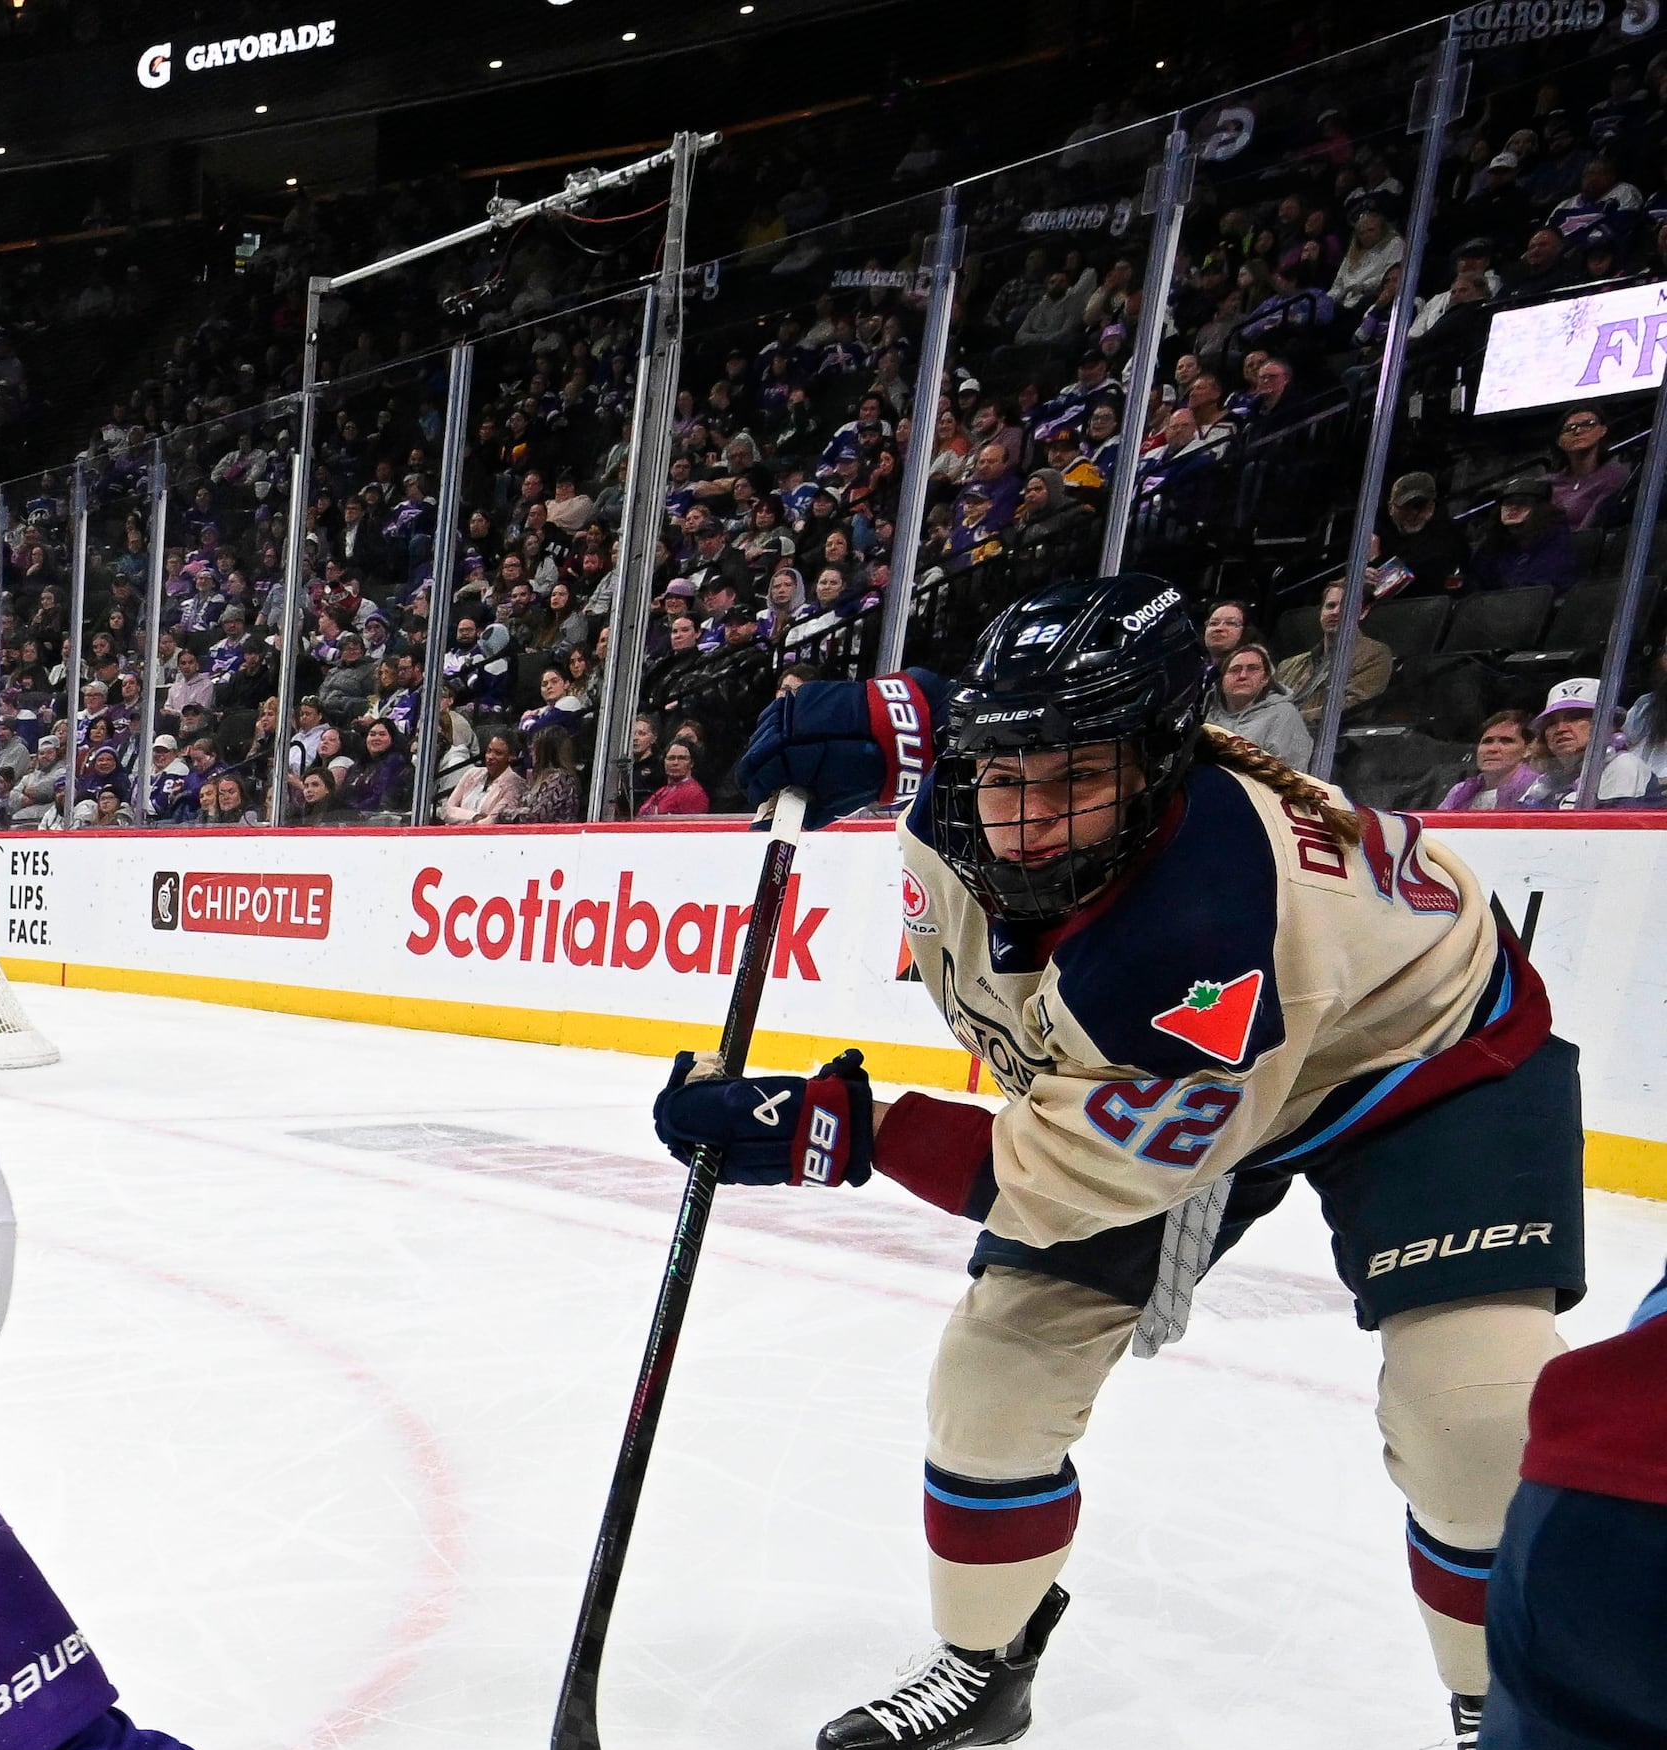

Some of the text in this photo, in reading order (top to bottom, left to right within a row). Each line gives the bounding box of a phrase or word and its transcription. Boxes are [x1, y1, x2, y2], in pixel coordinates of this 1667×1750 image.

[185, 19, 336, 72] GATORADE
[1136, 587, 1181, 630] ROGERS
[1014, 623, 1065, 648] 22
[975, 706, 1046, 725] BAUER
[10, 850, 54, 877] EYES.
[9, 885, 48, 911] LIPS.
[186, 885, 325, 926] CHIPOTLE
[8, 918, 52, 946] FACE.
[405, 865, 830, 982] Scotiabank
[903, 917, 937, 934] NADA
[1083, 1077, 1245, 1170] 22
[1366, 1221, 1554, 1280] BAUER
